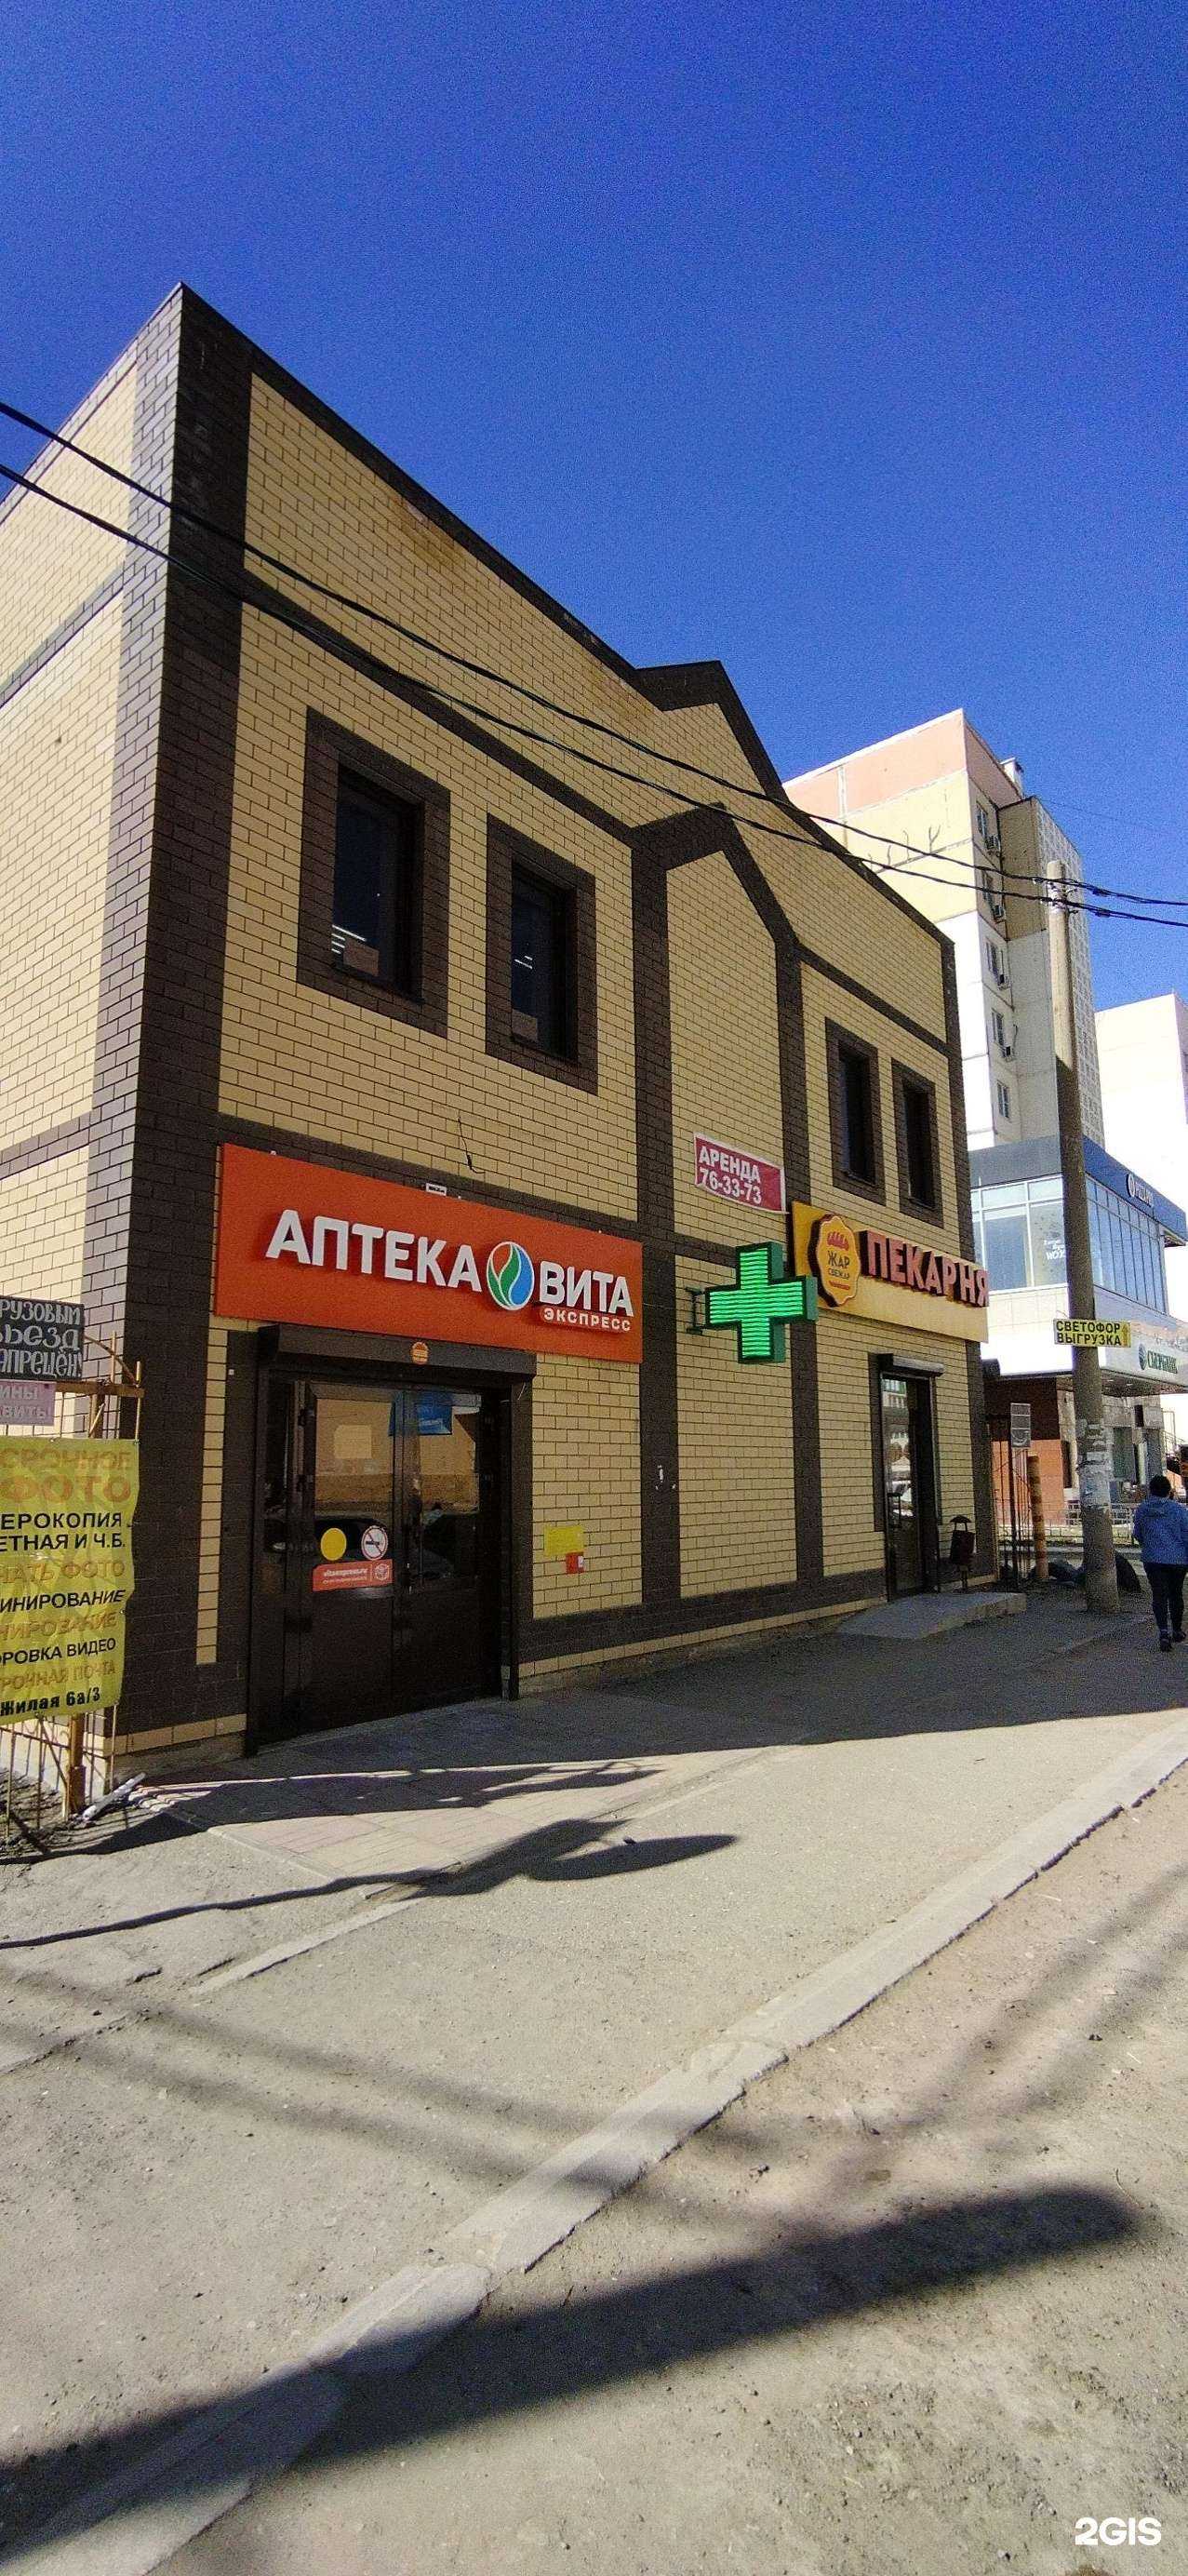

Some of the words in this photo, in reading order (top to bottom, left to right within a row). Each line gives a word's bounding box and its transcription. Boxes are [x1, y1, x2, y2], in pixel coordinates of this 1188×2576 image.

[699, 1146, 761, 1185] АРЕНДА
[700, 1166, 762, 1204] 76-33-73
[266, 1209, 483, 1293] АПТЕКА
[540, 1260, 634, 1317] ВИТА
[827, 1250, 850, 1268] ЖАР
[865, 1230, 989, 1308] ПЕКАРНЯ
[543, 1308, 631, 1332] ЭКСПРЕСС
[1056, 1321, 1120, 1334] СВЕТОФОР
[1057, 1332, 1122, 1346] ВЫГРУЗКА
[0, 1474, 130, 1503] ФОТО
[1, 1512, 122, 1530] ЕРОКОПИЯ
[74, 1534, 87, 1549] И
[94, 1533, 126, 1548] Ч.Б.
[60, 1561, 125, 1579] ФОТО
[0, 1589, 126, 1613] ИНИРОВАНИЕ
[0, 1646, 62, 1665] РОВКА
[67, 1638, 116, 1657] ВИДЕО
[0, 1696, 60, 1716] Жилая
[66, 1686, 100, 1706] 6а/3
